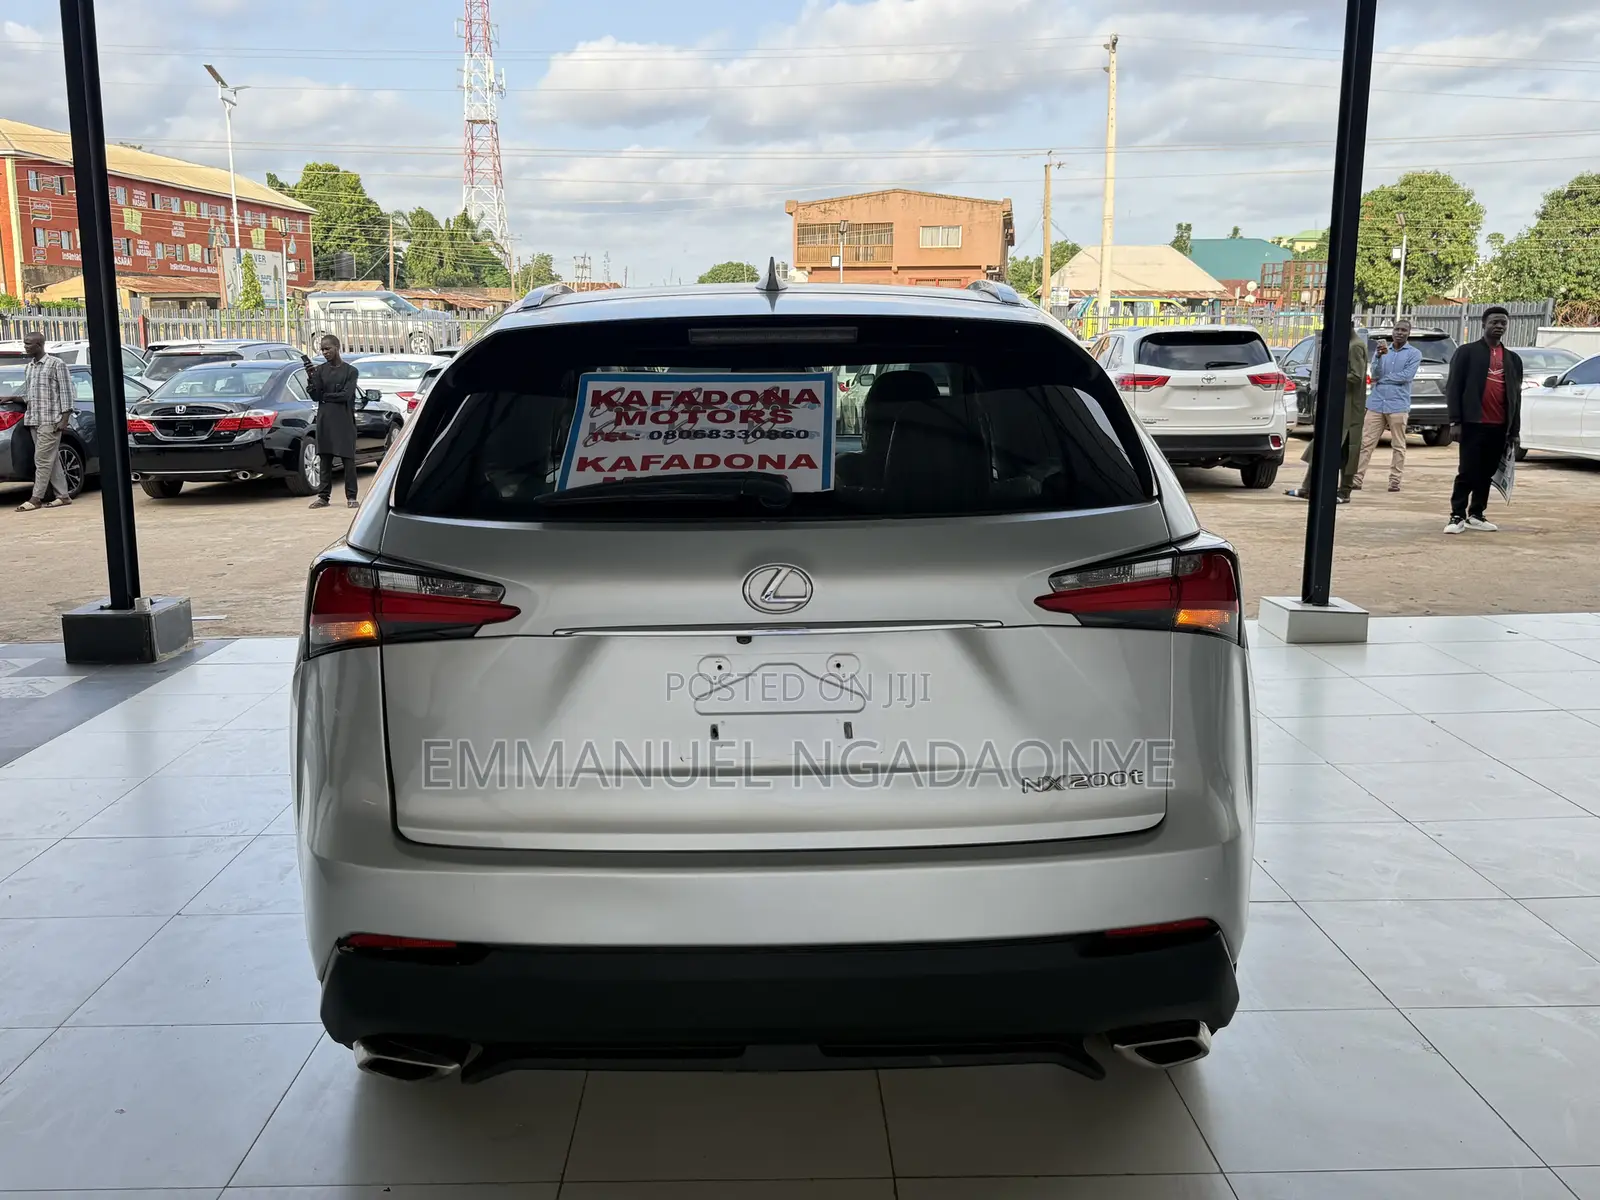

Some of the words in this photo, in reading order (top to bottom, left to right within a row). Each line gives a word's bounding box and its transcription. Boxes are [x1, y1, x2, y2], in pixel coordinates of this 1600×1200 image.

[590, 388, 821, 408] KAFADONA
[614, 409, 794, 426] MOTORS
[649, 429, 809, 441] 08068330860
[576, 454, 818, 472] KAFADONA
